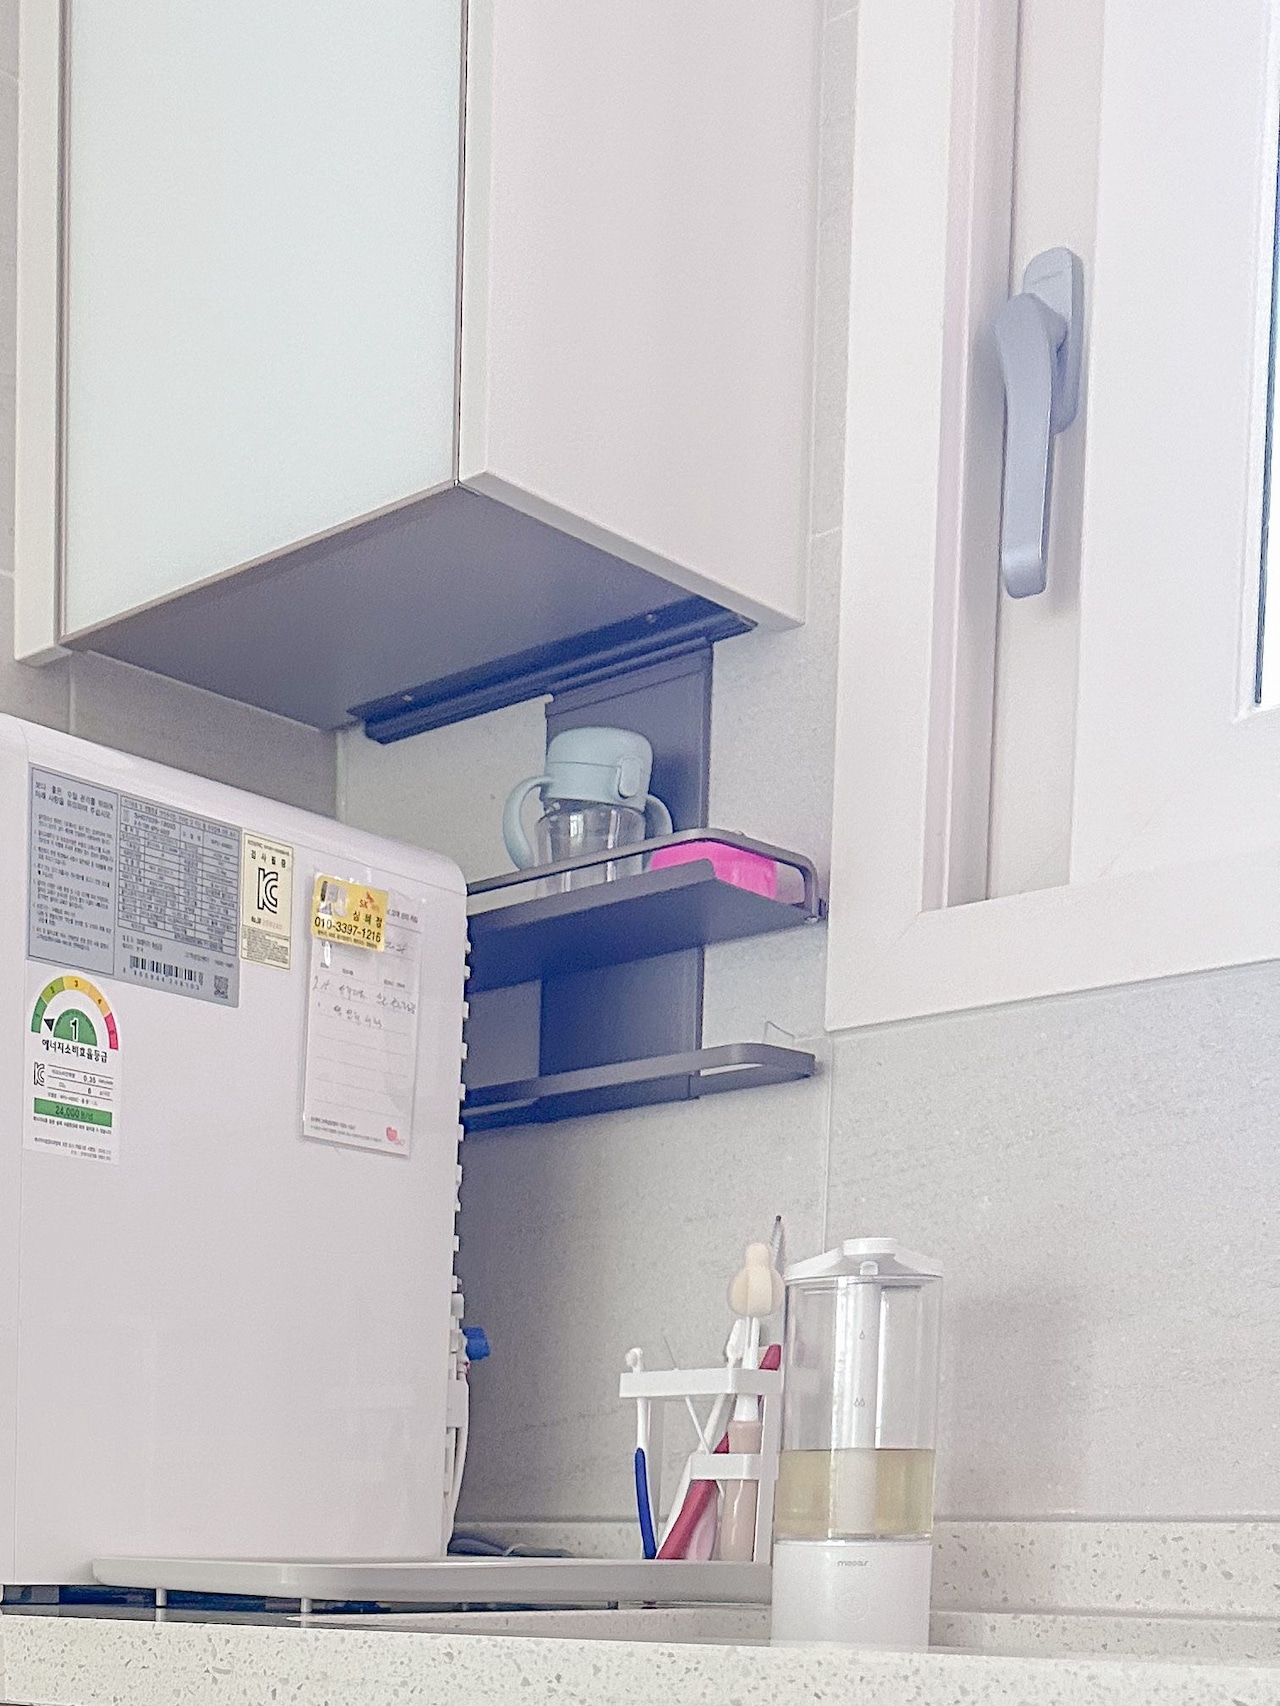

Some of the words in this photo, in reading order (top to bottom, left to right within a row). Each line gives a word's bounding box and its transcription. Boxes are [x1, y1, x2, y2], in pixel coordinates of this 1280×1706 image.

[314, 916, 382, 943] 010-3397-1216
[71, 1018, 78, 1041] 1
[41, 1039, 108, 1064] 에너지소비효율등급
